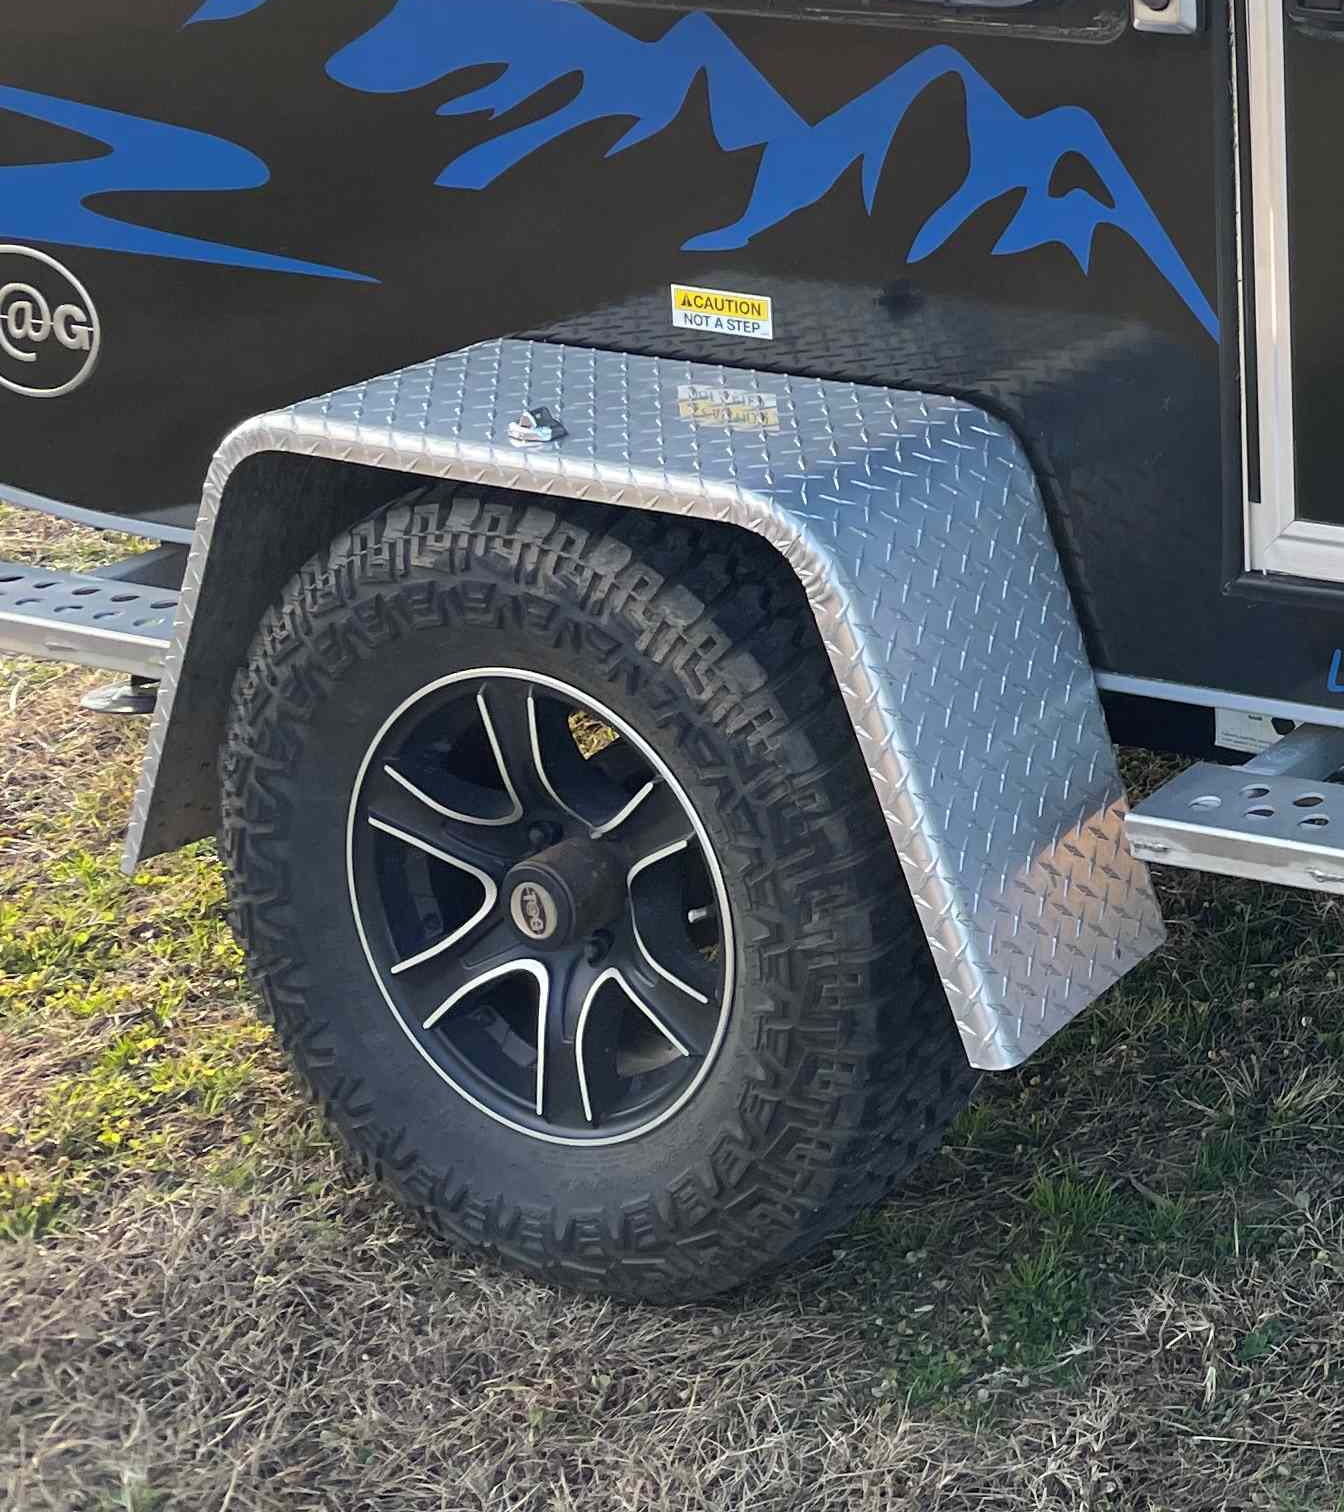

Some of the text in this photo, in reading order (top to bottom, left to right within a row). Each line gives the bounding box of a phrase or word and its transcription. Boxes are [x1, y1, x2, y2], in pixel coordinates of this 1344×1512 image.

[693, 294, 761, 316] CAUTION
[684, 313, 760, 334] NOT A STEP
